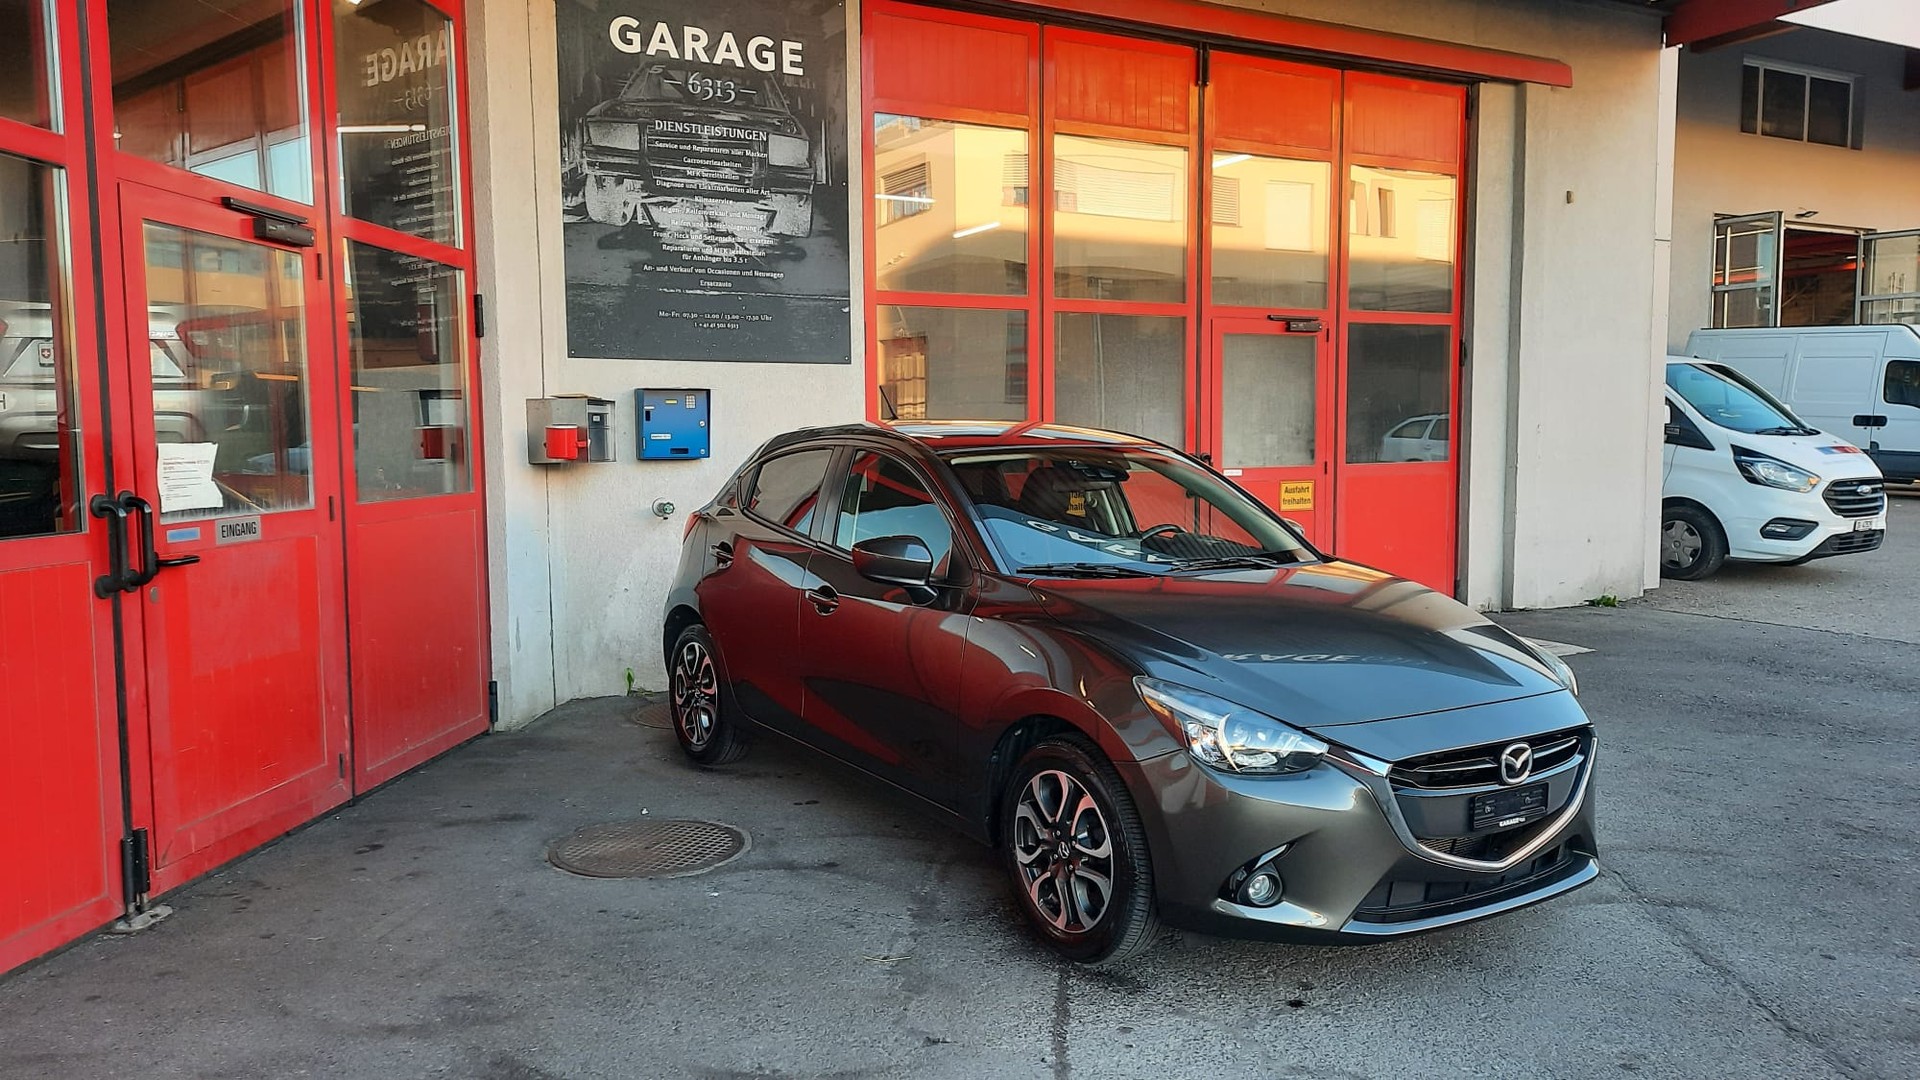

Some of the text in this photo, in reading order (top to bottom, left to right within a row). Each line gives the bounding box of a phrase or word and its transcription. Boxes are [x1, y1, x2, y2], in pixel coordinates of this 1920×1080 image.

[608, 15, 804, 76] GARAGE
[687, 71, 736, 104] 6313
[655, 120, 767, 141] DIENSTLEISTUNGEN
[655, 141, 768, 158] Service und Reparaturen aller Marken
[656, 179, 685, 190] Diagnose
[685, 181, 697, 190] und
[746, 187, 759, 195] aller
[760, 188, 770, 196] Art
[694, 195, 733, 205] Klimaservice
[662, 244, 701, 253] Reparaturen
[682, 253, 692, 261] für
[692, 254, 722, 264] Anhänger
[670, 266, 693, 274] Verkauf
[707, 268, 741, 276] Occasionen
[754, 270, 784, 279] Neuwagen
[760, 314, 773, 322] Uhr
[1284, 486, 1310, 494] Ausfahrt
[1282, 497, 1311, 506] freihalten
[221, 521, 257, 539] EINGANG
